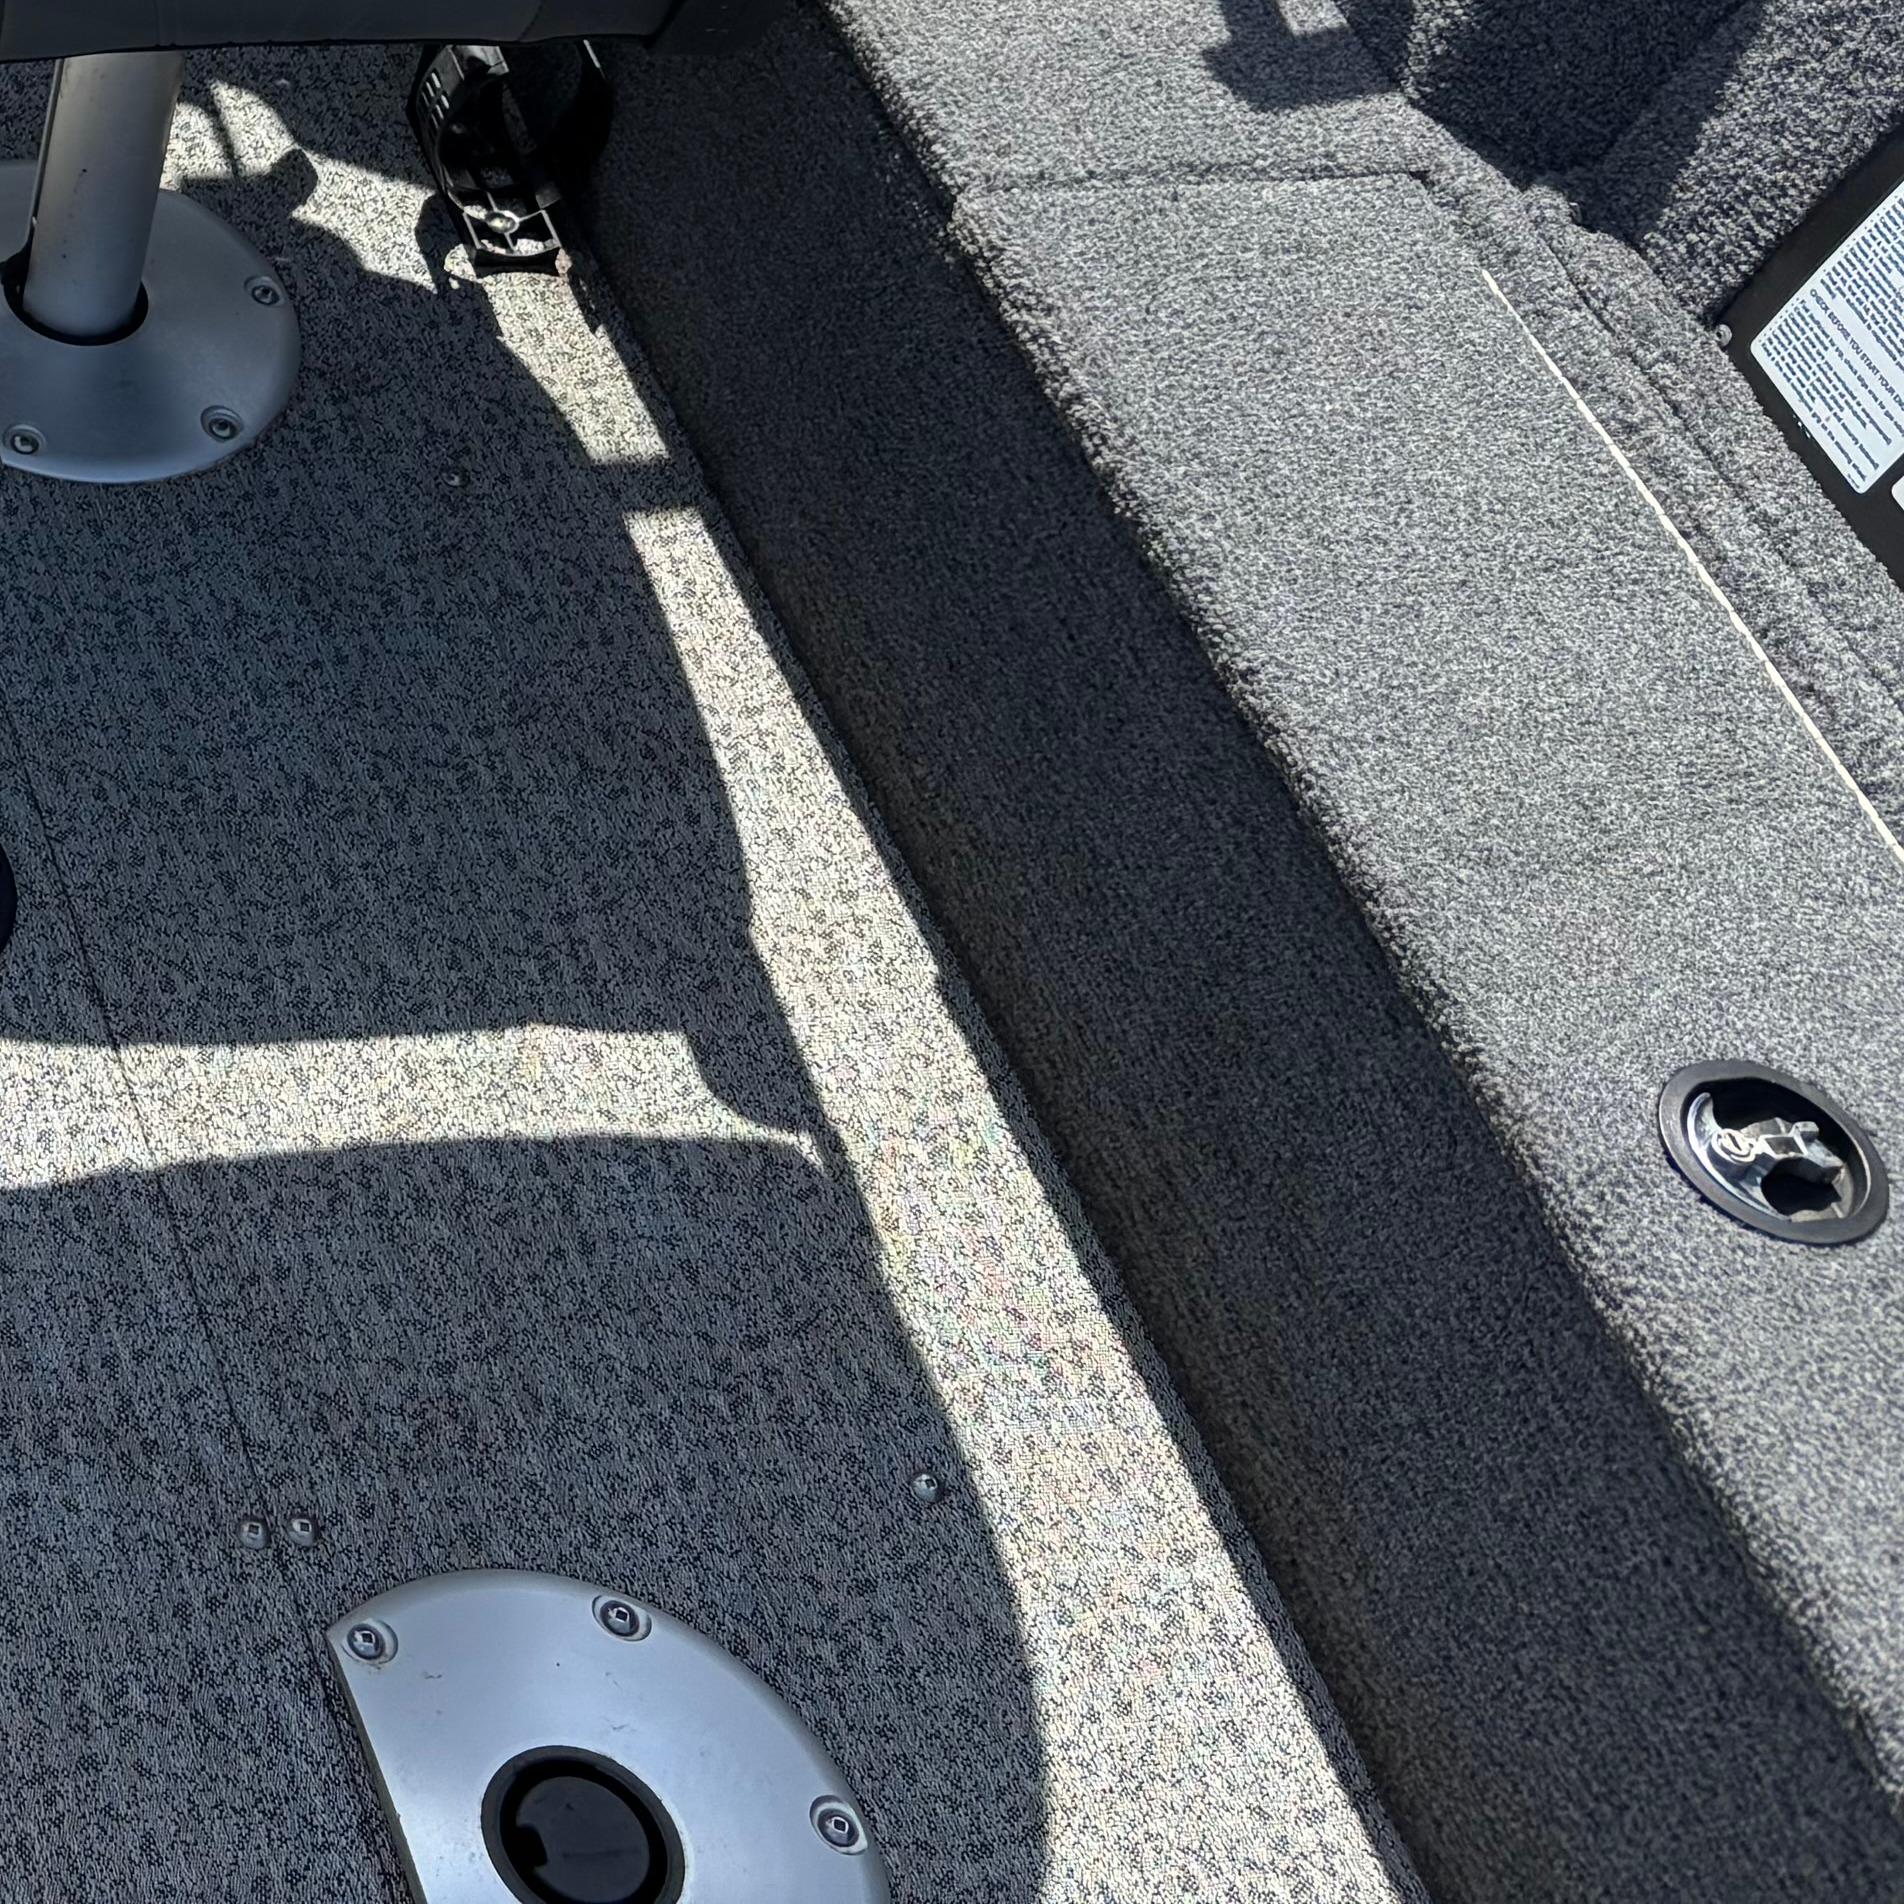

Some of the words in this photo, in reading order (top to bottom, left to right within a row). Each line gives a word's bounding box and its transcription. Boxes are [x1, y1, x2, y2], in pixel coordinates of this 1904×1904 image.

[1810, 288, 1830, 314] CHECK
[1827, 311, 1851, 341] BEFORE
[1849, 337, 1863, 355] YOU
[1860, 352, 1880, 376] START
[1878, 374, 1896, 397] YOUR
